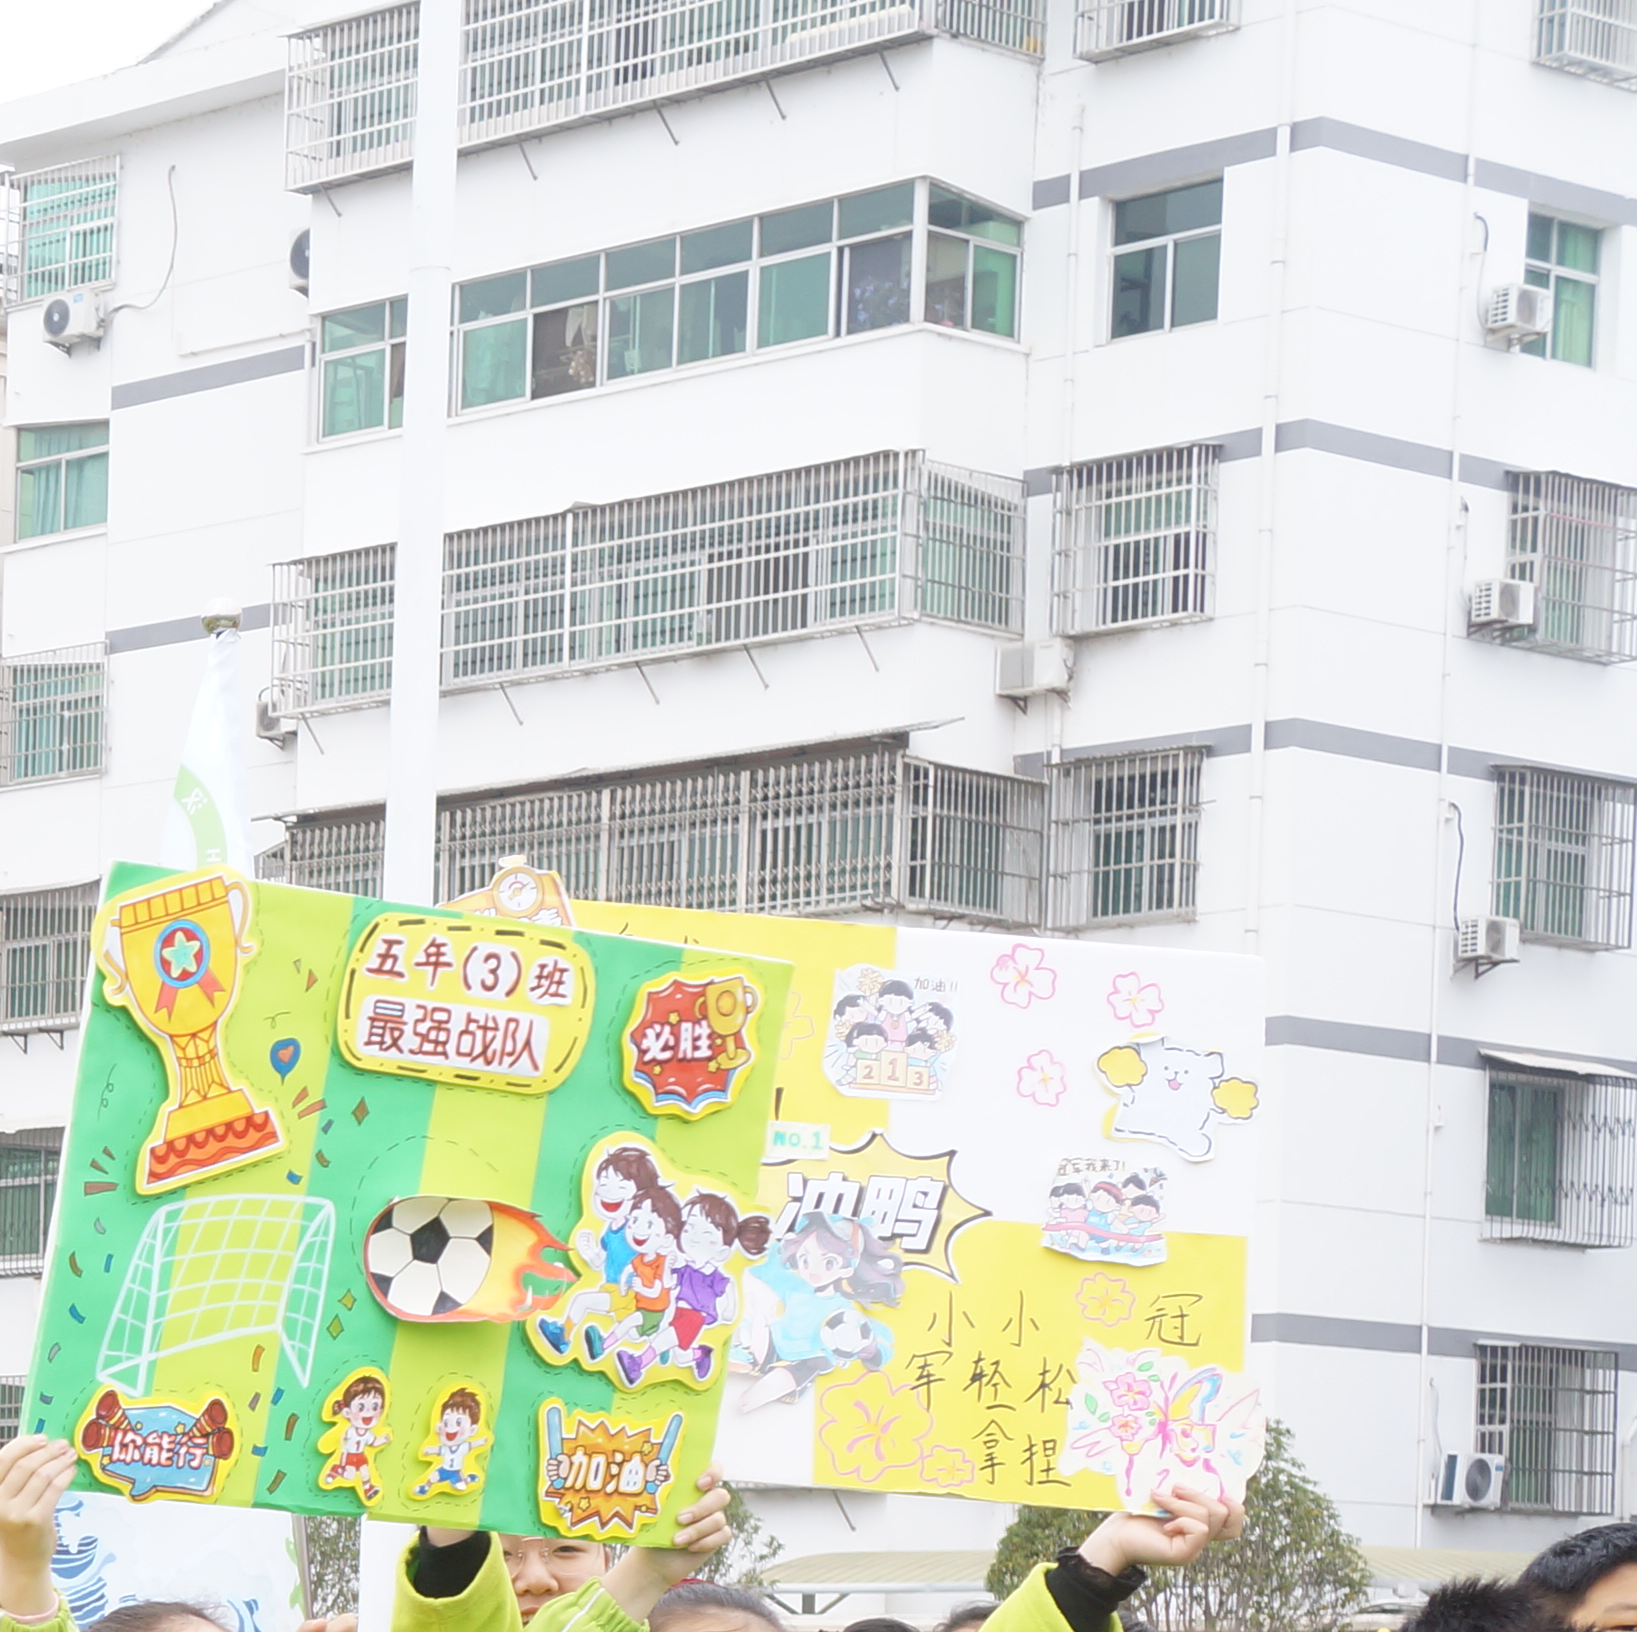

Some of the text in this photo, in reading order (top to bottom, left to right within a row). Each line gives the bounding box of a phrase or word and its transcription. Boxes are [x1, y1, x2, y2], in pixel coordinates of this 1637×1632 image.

[365, 936, 570, 1000] 五年(3)班
[363, 998, 541, 1073] 最强战队
[640, 1019, 713, 1063] 必胜
[862, 1056, 925, 1087] 2 1 3
[772, 1130, 823, 1150] NO.1
[775, 1171, 947, 1254] 冲鸭
[927, 1289, 1204, 1348] 小小 冠
[905, 1349, 1077, 1414] 军轻松
[111, 1429, 208, 1470] 你能行
[563, 1445, 646, 1495] 加油
[972, 1418, 1072, 1487] 拿捏
